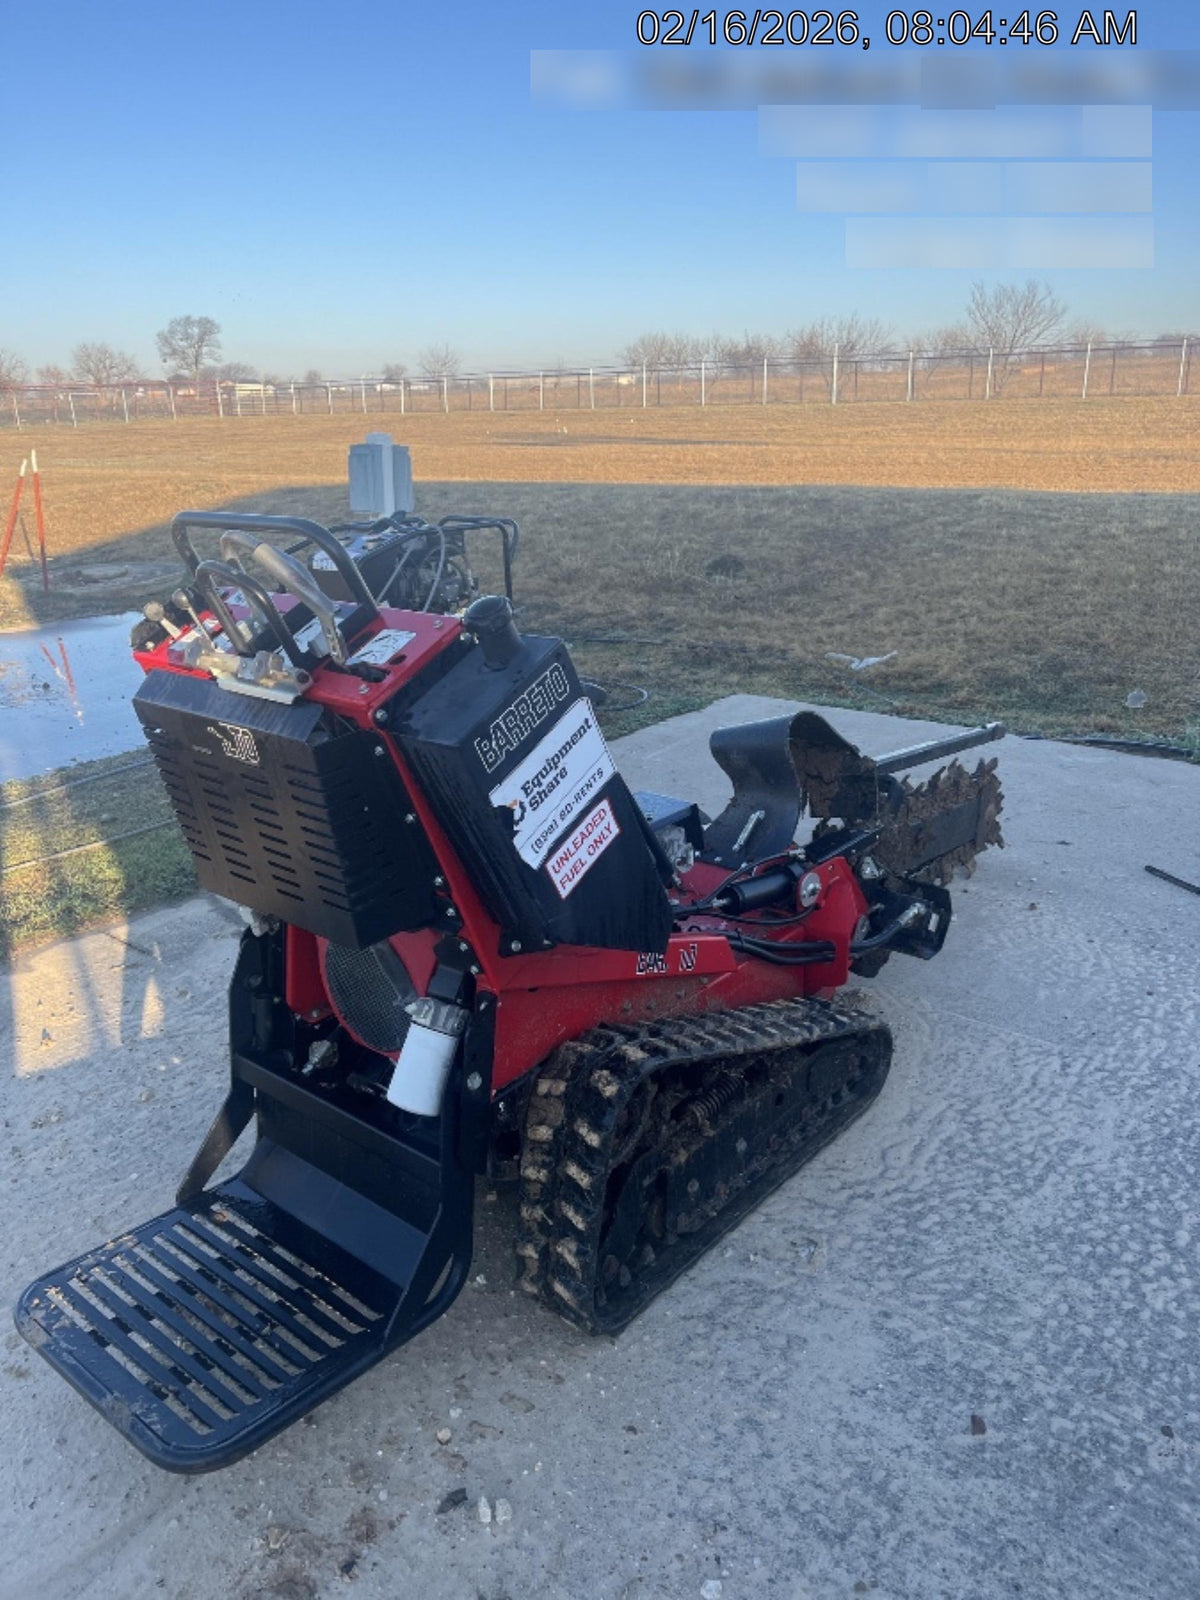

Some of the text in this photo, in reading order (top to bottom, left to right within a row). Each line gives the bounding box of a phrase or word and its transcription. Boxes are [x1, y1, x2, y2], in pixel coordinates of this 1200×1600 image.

[474, 663, 569, 773] BARRETO
[520, 717, 592, 799] Equipment
[528, 765, 568, 812] Share
[552, 808, 607, 875] UNLEADED
[559, 822, 613, 890] FUEL ONLY
